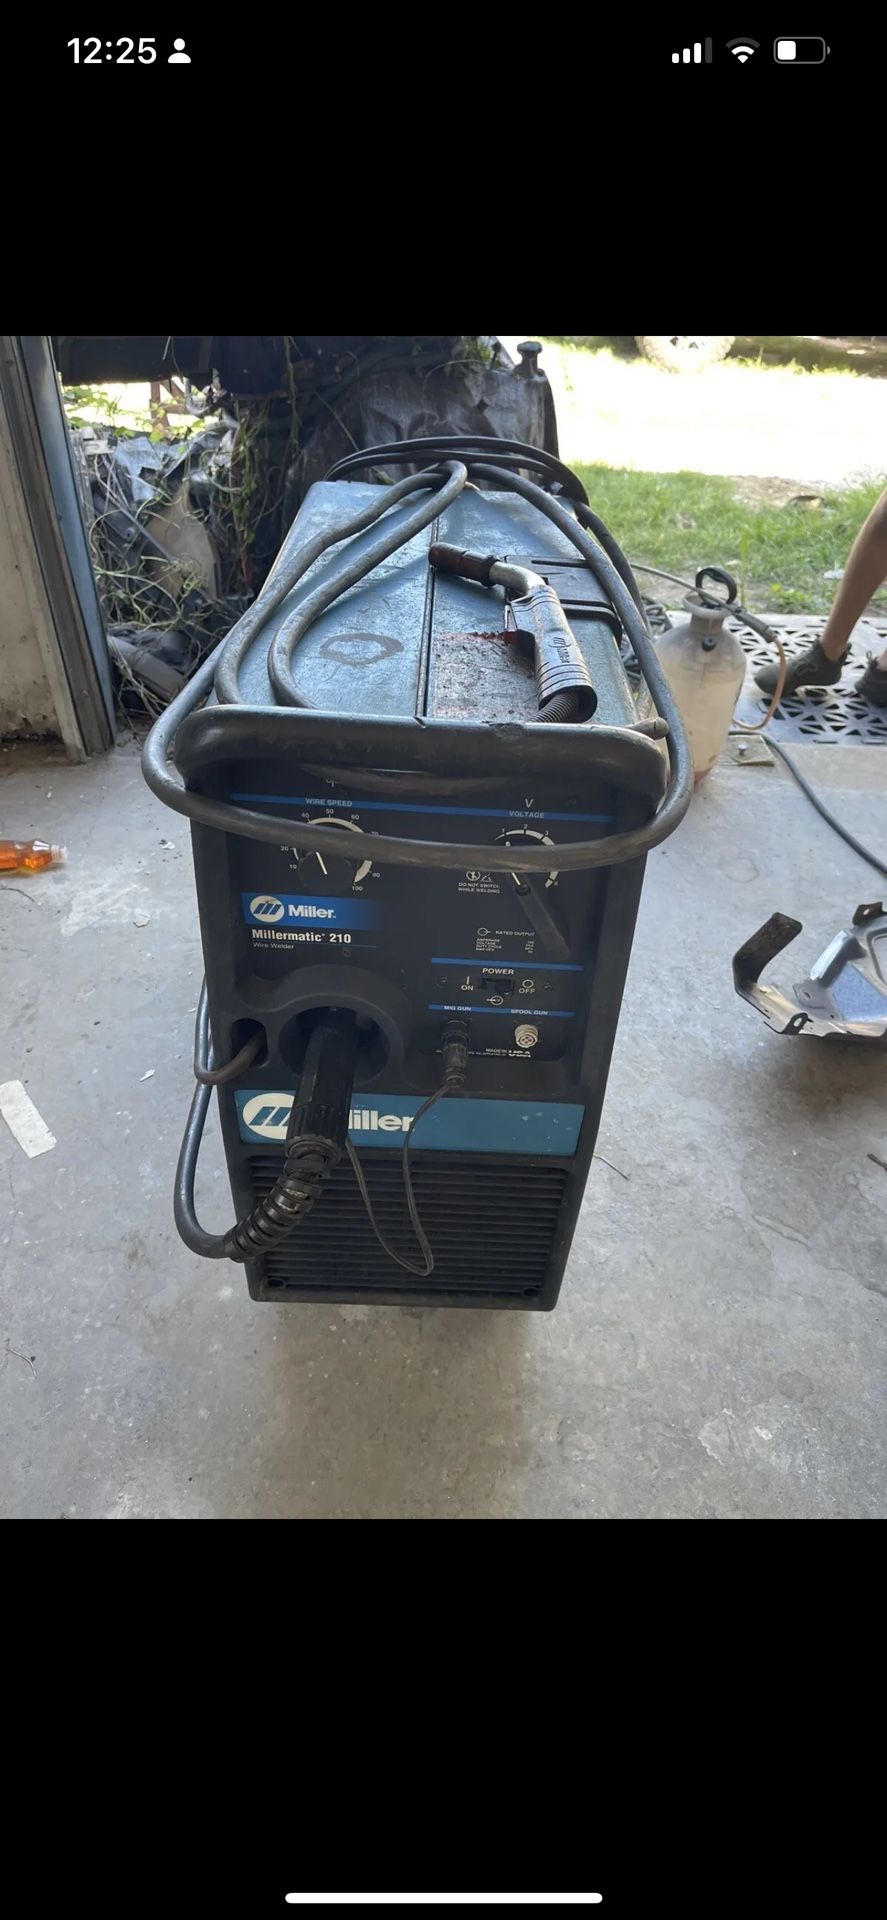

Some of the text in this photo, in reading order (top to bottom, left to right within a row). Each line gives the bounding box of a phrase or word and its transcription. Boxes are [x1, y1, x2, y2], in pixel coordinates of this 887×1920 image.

[305, 798, 353, 807] WIRE SPEED
[525, 798, 534, 808] V
[509, 810, 545, 819] VOLTAGE
[329, 933, 352, 944] 210
[482, 967, 514, 975] POWER
[349, 1109, 415, 1132] iller
